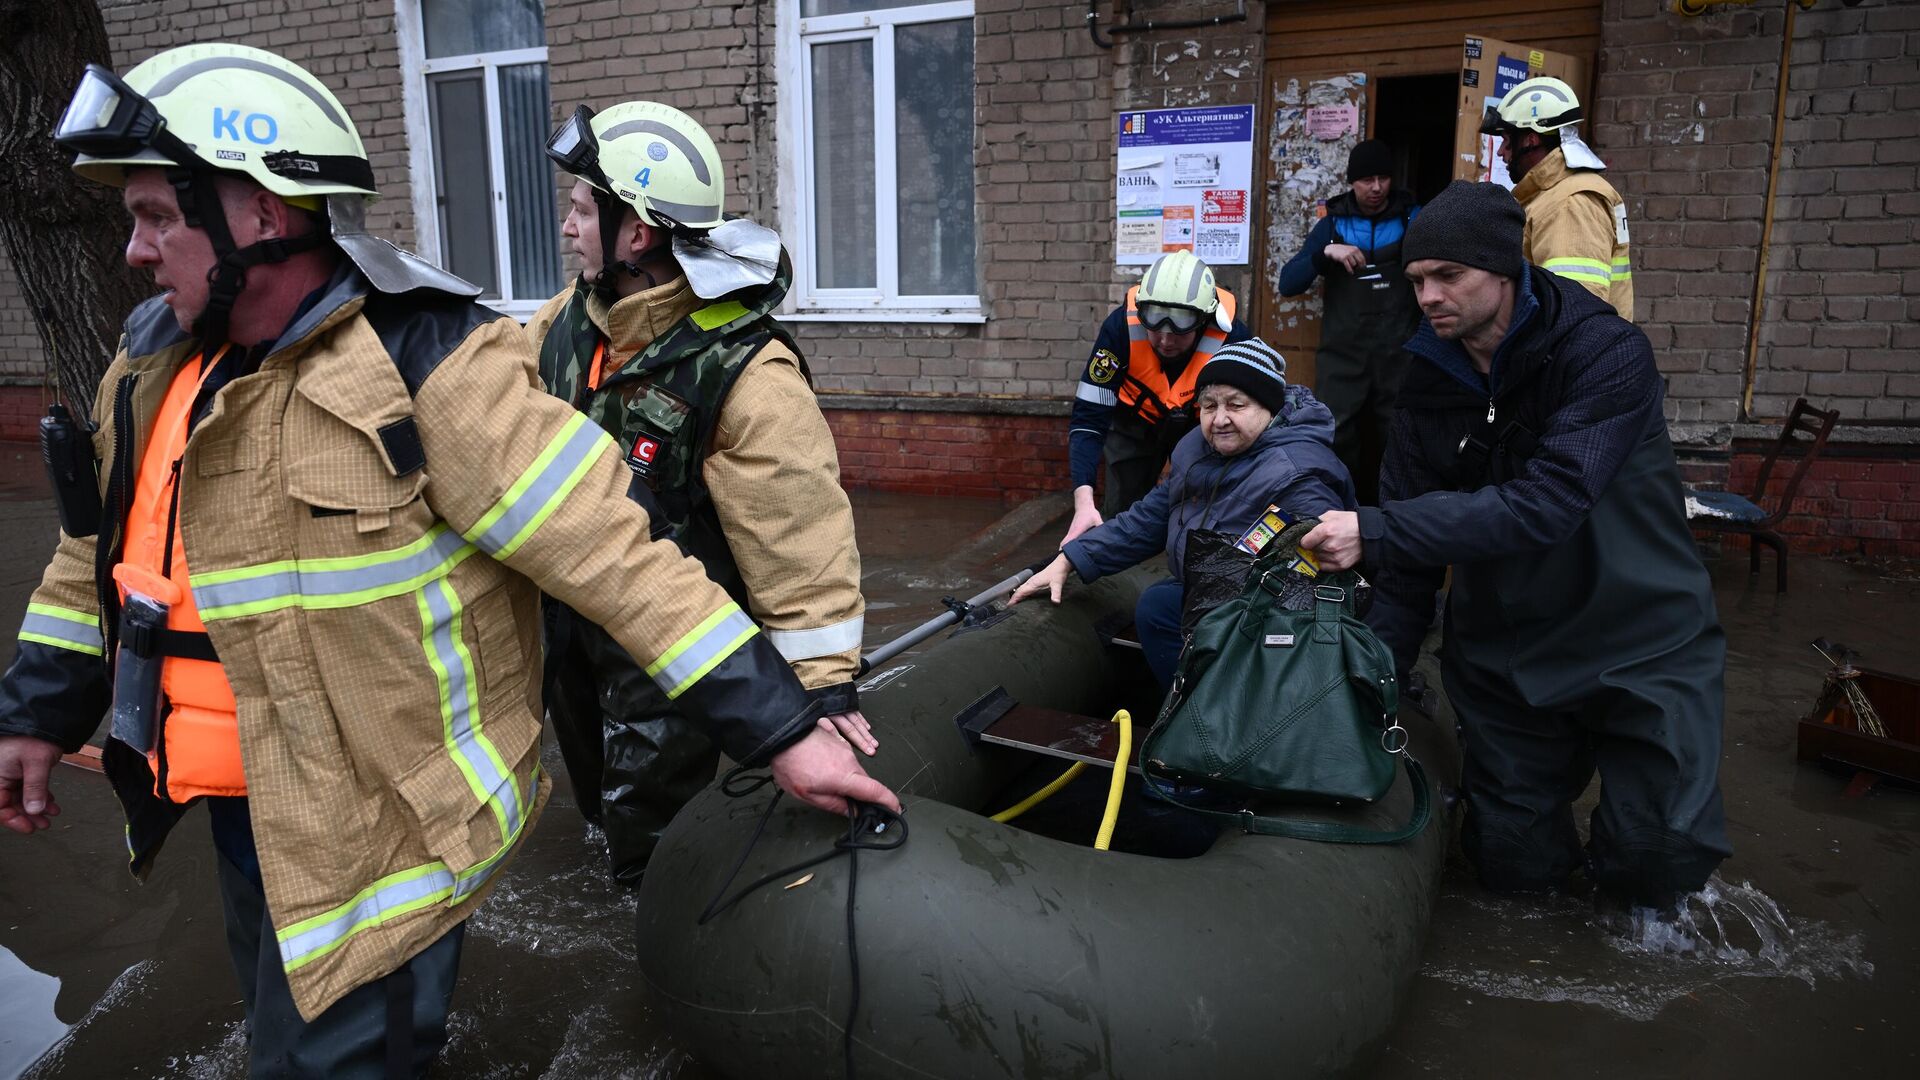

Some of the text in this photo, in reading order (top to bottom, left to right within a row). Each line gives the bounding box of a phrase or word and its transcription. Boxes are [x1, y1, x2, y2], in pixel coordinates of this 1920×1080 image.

[1530, 106, 1538, 117] 1
[1174, 113, 1245, 125] Альтернатива»
[217, 151, 245, 160] MSA
[634, 167, 651, 189] 4
[639, 441, 654, 458] C
